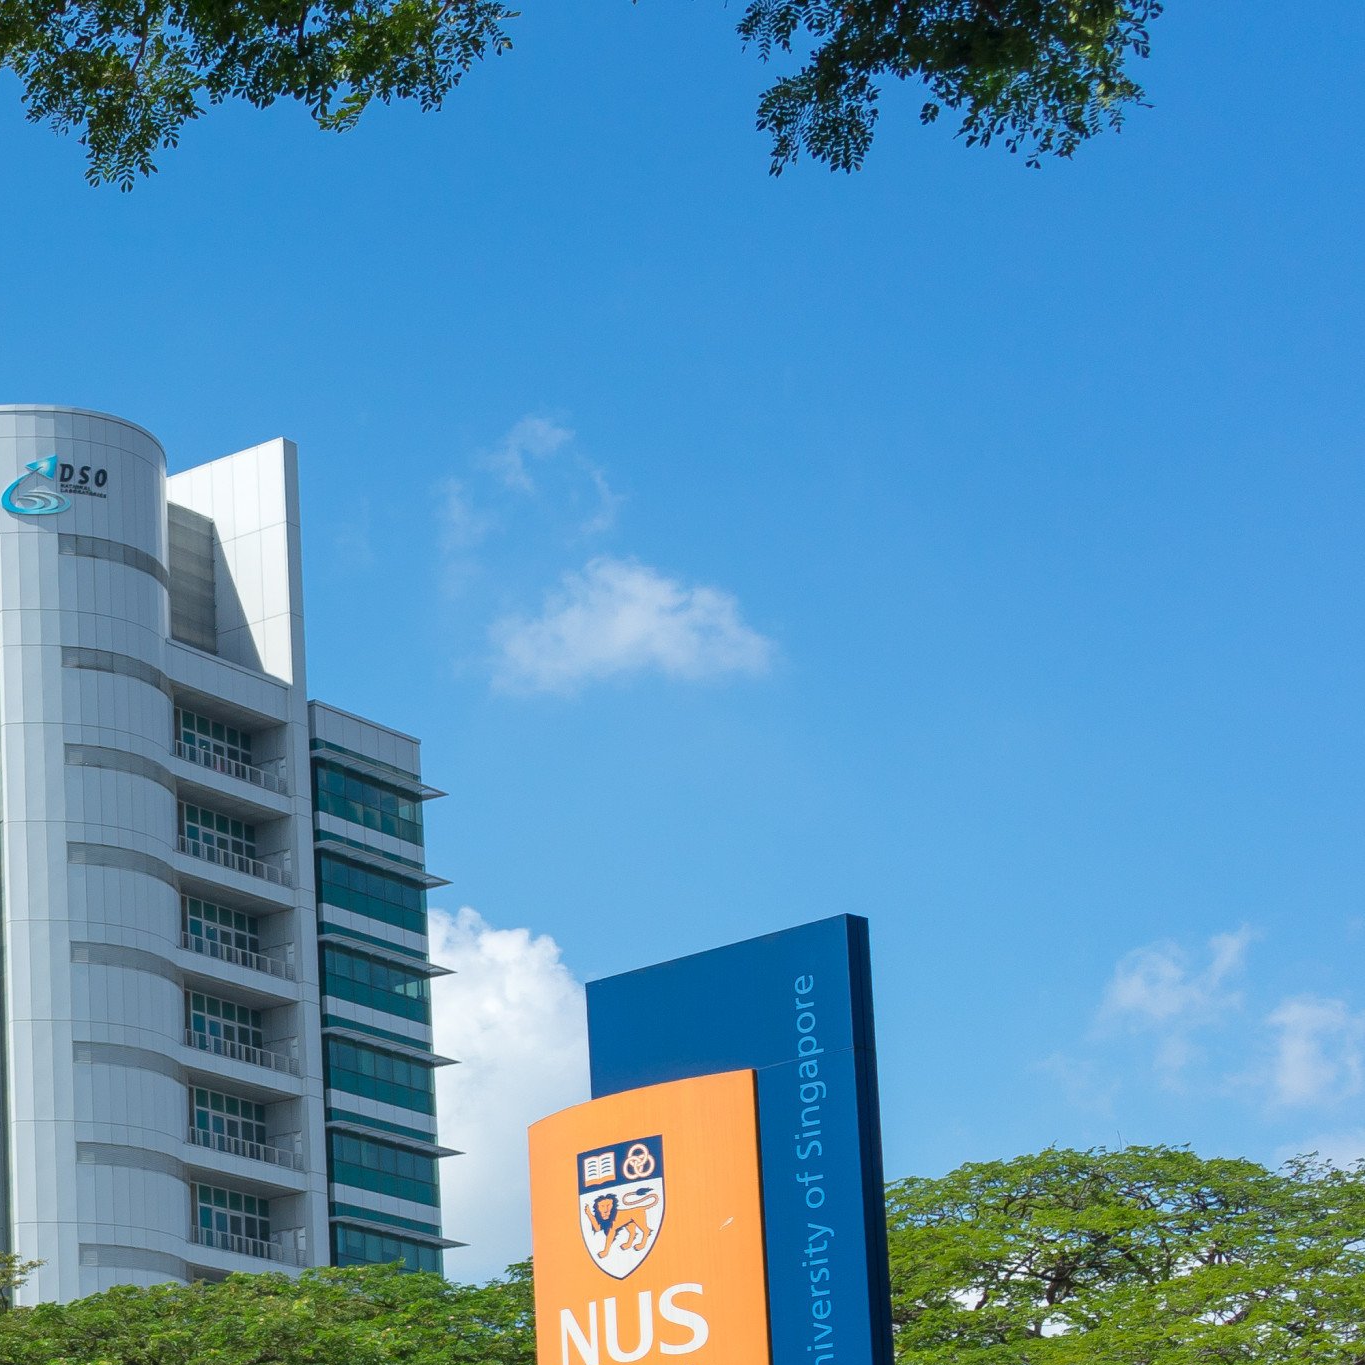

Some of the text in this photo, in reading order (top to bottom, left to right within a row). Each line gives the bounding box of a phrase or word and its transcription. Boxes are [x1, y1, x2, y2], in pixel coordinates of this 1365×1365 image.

[60, 463, 107, 487] DSO
[794, 974, 827, 1160] Singapore
[795, 1172, 826, 1209] of
